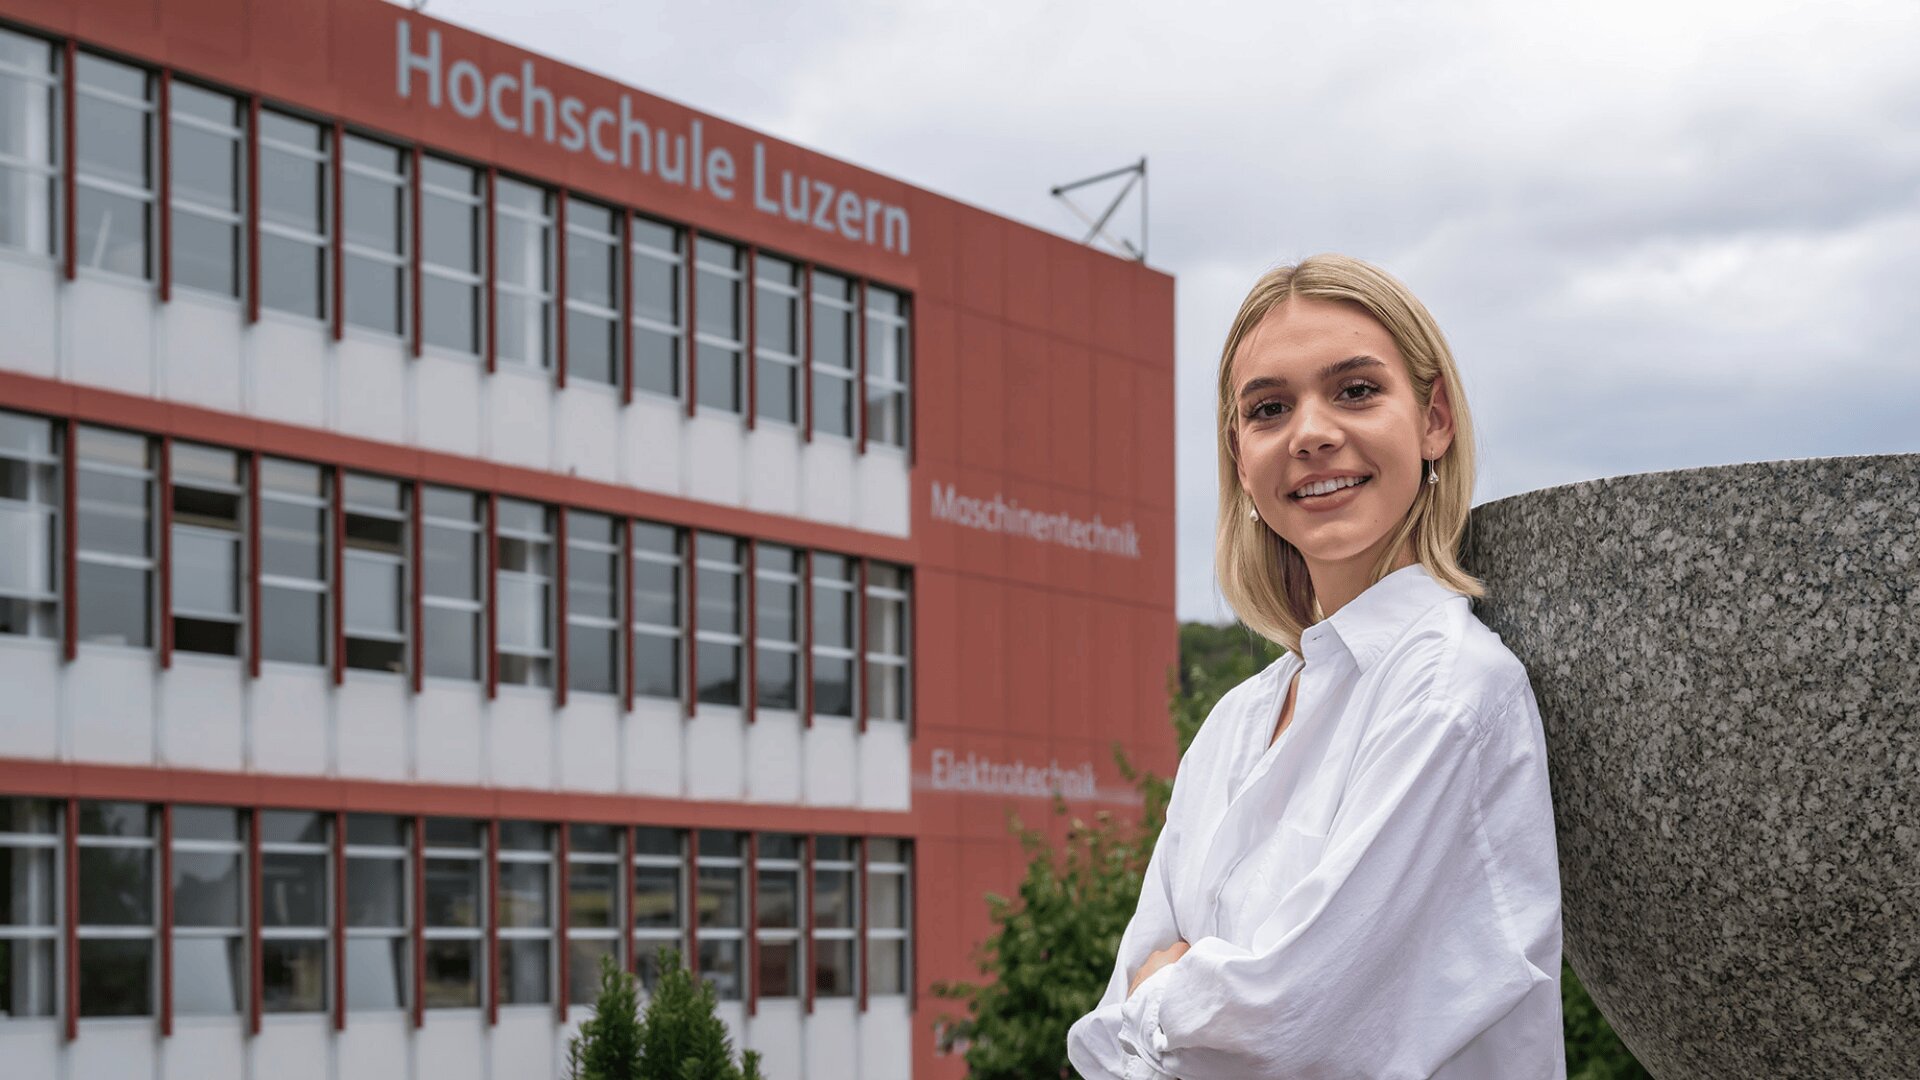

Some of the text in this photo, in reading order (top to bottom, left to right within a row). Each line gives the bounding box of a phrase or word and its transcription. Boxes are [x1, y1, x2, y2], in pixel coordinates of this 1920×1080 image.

[396, 18, 910, 255] Hochschule Luzern
[931, 480, 1141, 559] Maschinentechnik
[931, 748, 1096, 797] Elektrotechnik
